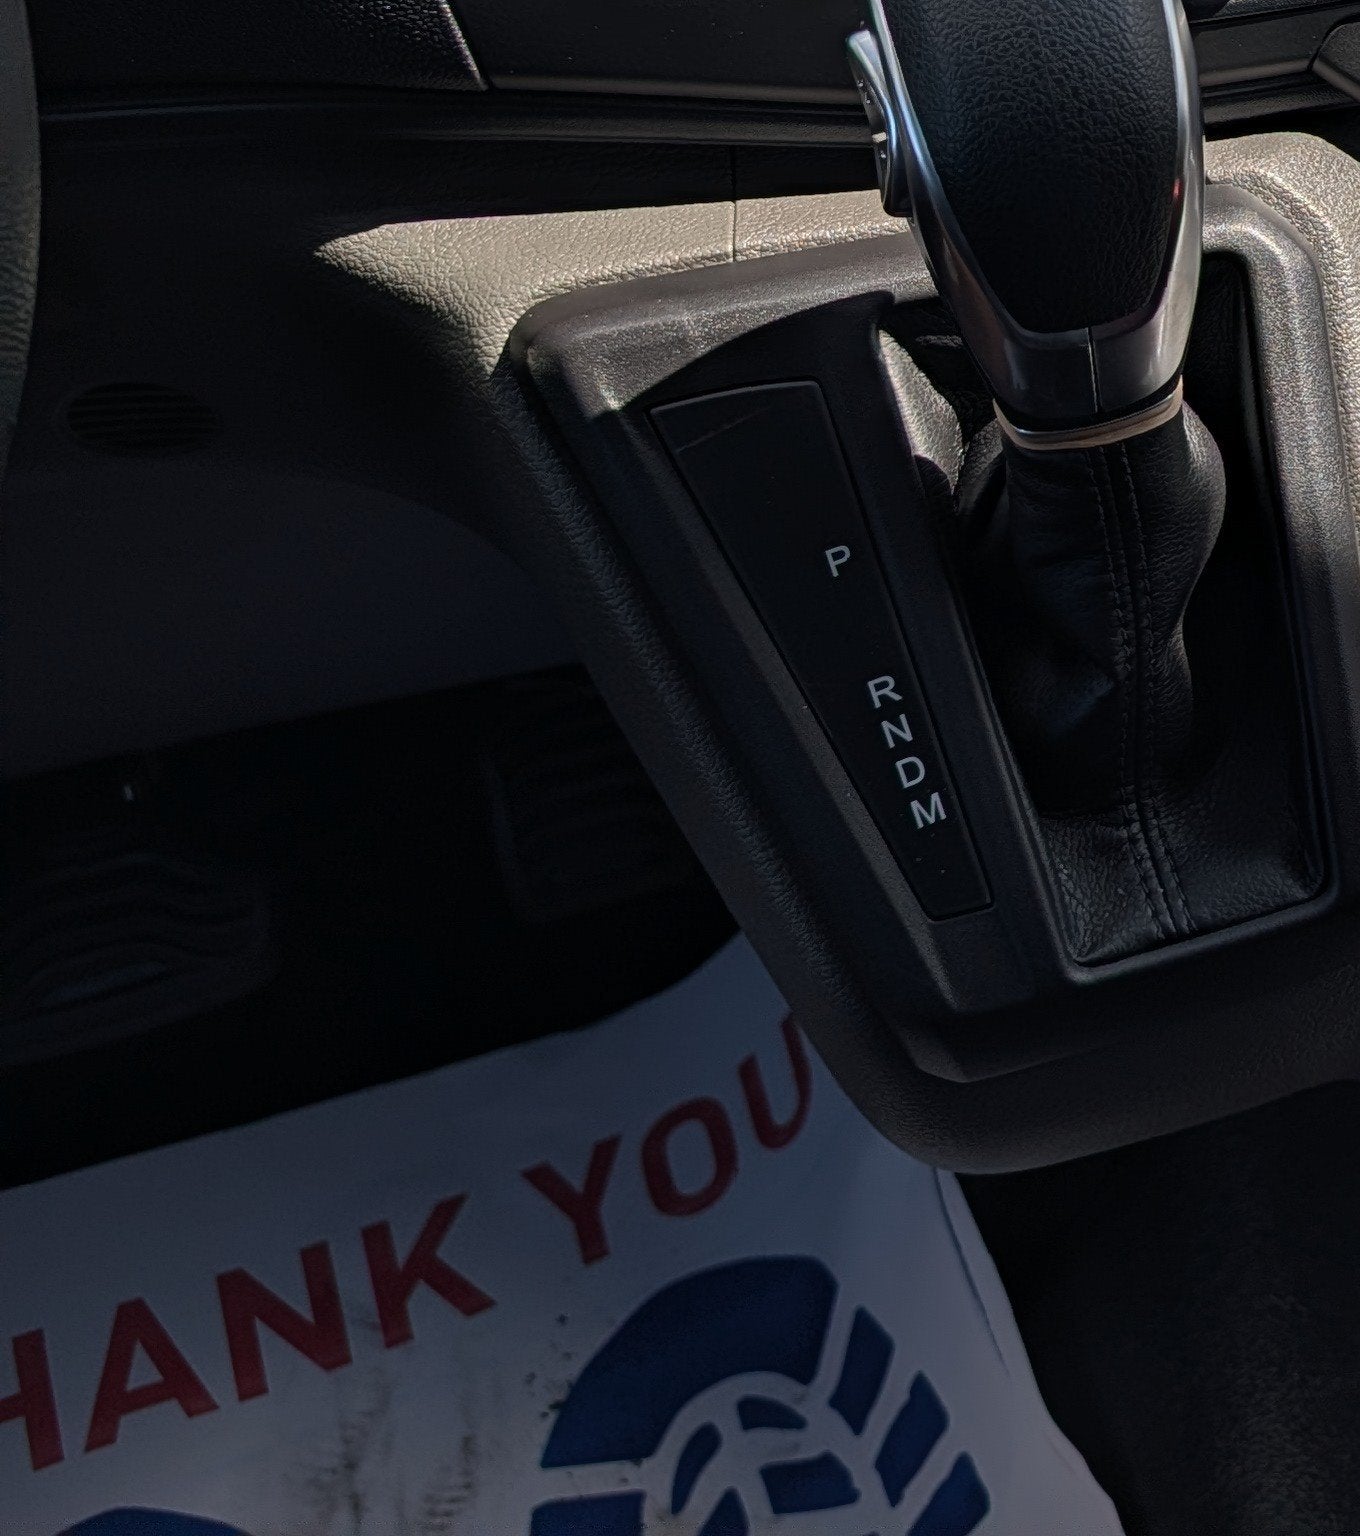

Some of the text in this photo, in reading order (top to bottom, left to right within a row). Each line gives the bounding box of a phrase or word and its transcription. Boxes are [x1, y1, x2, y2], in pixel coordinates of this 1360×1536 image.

[824, 544, 852, 578] P
[866, 674, 903, 709] R
[880, 713, 914, 749] N
[894, 755, 926, 790] D
[909, 791, 948, 830] M
[520, 1014, 813, 1267] YOU
